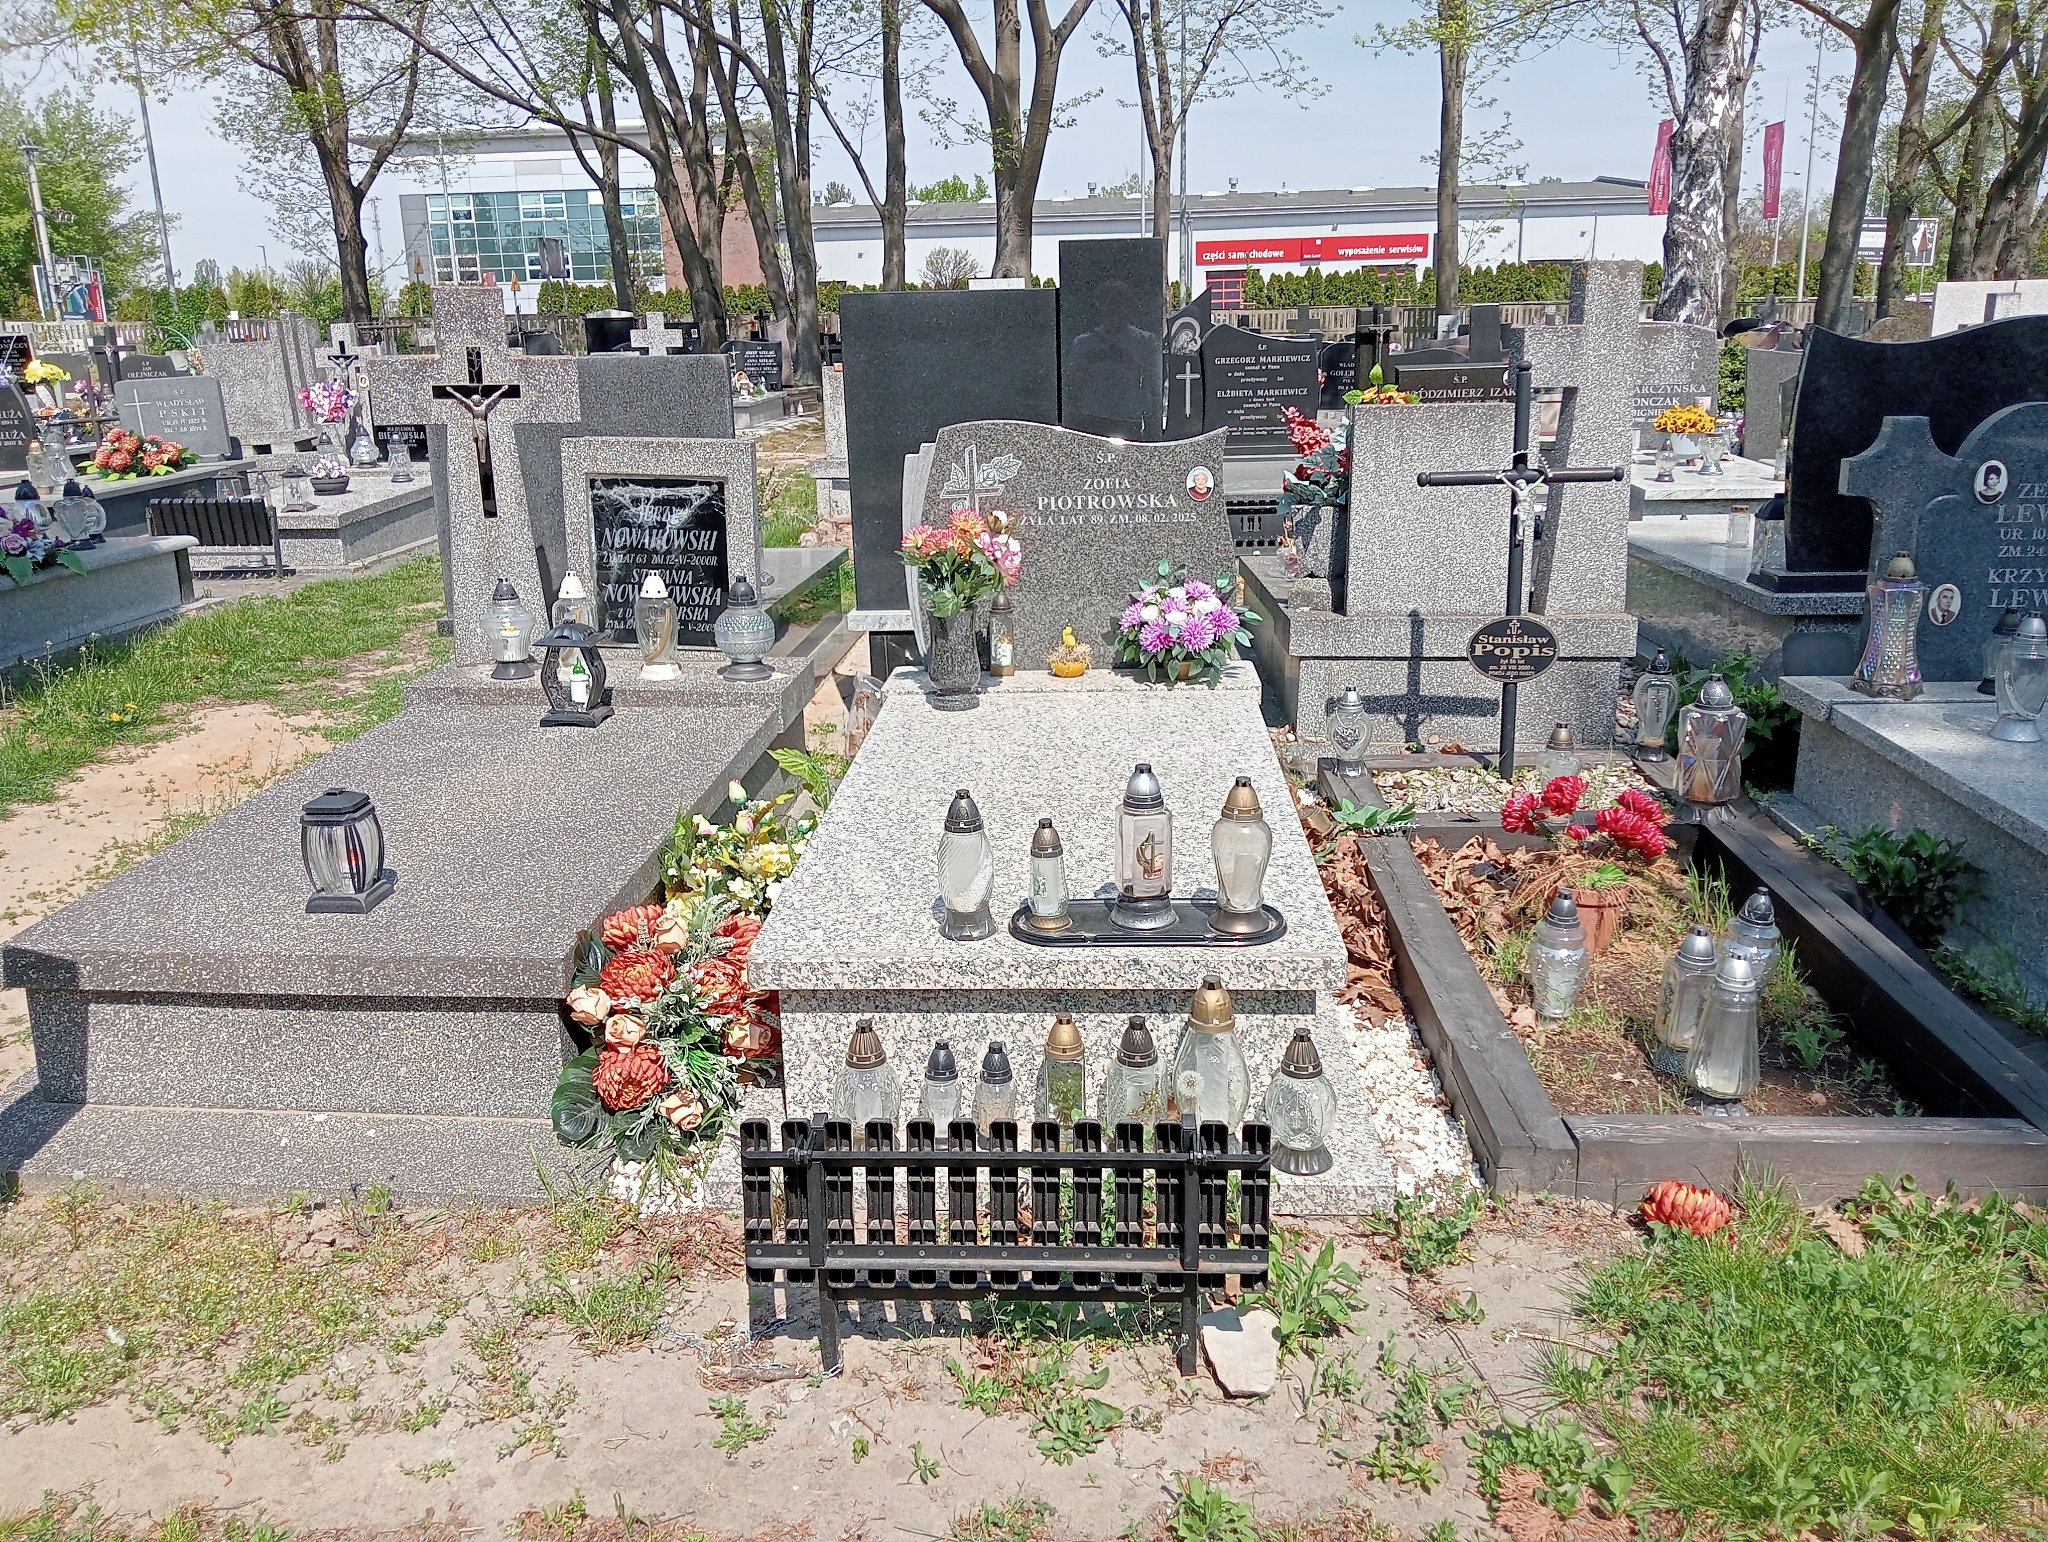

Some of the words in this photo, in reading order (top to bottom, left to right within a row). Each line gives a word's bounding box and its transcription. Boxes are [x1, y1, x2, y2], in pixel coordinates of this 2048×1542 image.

[1202, 252, 1225, 262] części
[1228, 249, 1285, 260] samochodowe
[1338, 246, 1386, 257] wyposażenie
[1388, 244, 1424, 254] serwisów
[1214, 356, 1256, 365] GRZEGORZ
[1260, 354, 1311, 363] MARKIEWICZ
[1217, 389, 1253, 398] ELŻBIETA
[1257, 388, 1308, 396] MARKIEWICZ
[155, 399, 205, 407] WŁADYSŁAW
[0, 409, 23, 418] UŻA
[1083, 478, 1131, 490] ZOFIA
[1037, 494, 1178, 511] PIOTROWSKA
[1061, 514, 1086, 525] LAT
[1090, 514, 1103, 525] 89
[1110, 513, 1132, 524] ZM.
[1172, 512, 1197, 523] 2025
[601, 527, 718, 551] NOWAKOWSKI
[636, 553, 648, 564] 63
[631, 568, 693, 585] STANIA
[604, 583, 722, 606] NOWOWSKA
[1478, 635, 1550, 644] Stanisław
[1472, 643, 1554, 659] Popis
